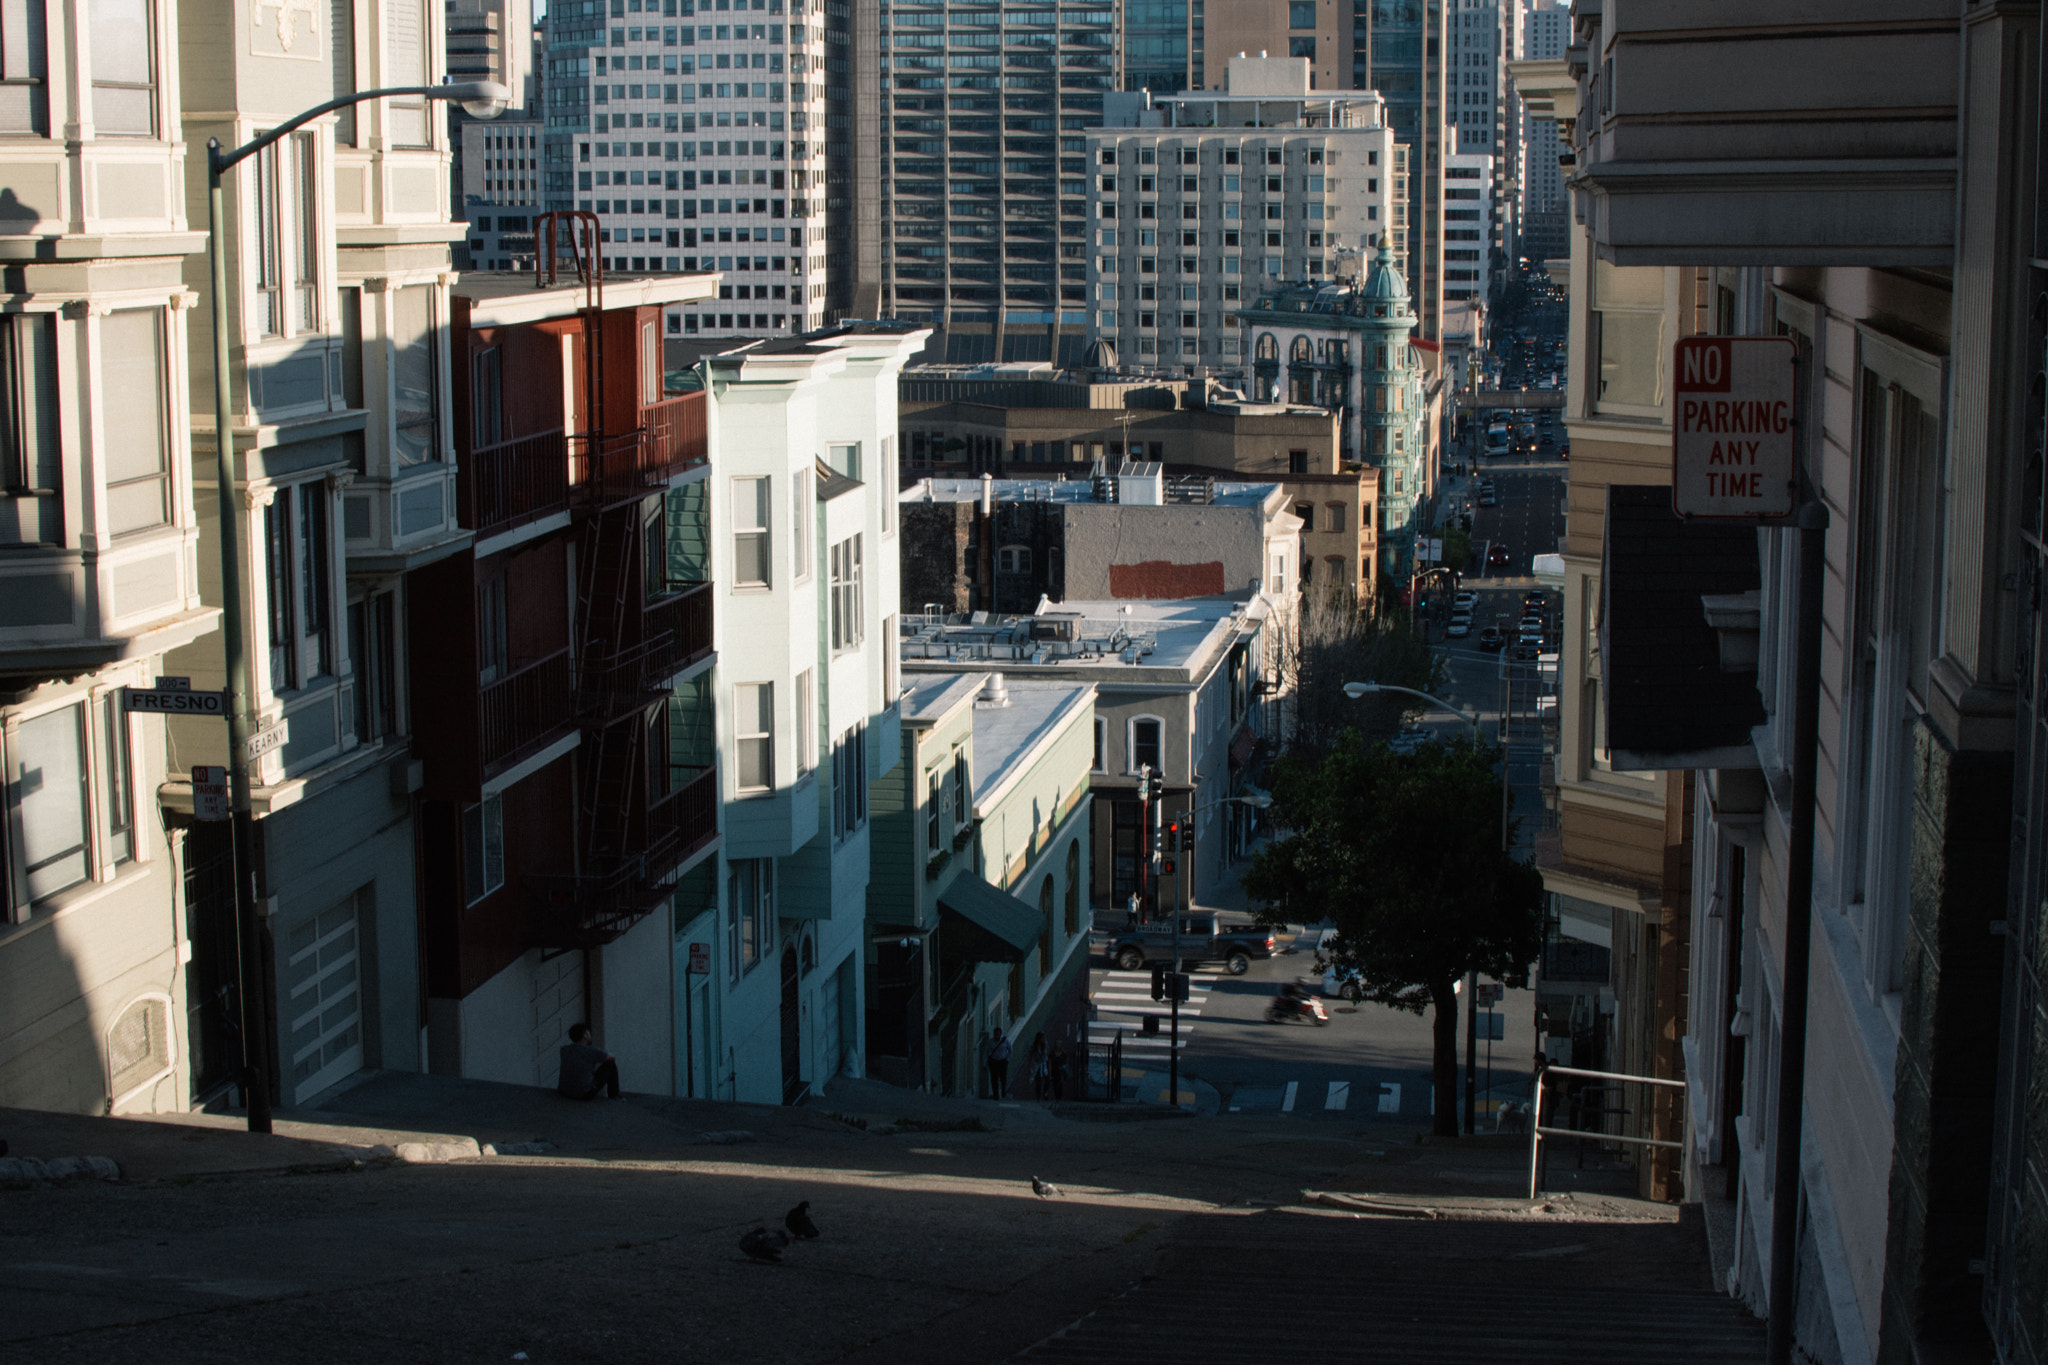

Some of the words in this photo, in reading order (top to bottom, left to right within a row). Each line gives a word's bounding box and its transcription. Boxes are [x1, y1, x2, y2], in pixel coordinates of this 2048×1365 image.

[1683, 345, 1722, 385] NO
[1683, 400, 1788, 434] PARKING
[1709, 440, 1760, 466] ANY
[1705, 472, 1763, 497] TIME
[132, 694, 218, 711] FRESNO
[248, 728, 284, 756] KEARNY
[194, 768, 207, 782] NO
[196, 784, 225, 796] PARKING
[204, 804, 219, 814] TIME
